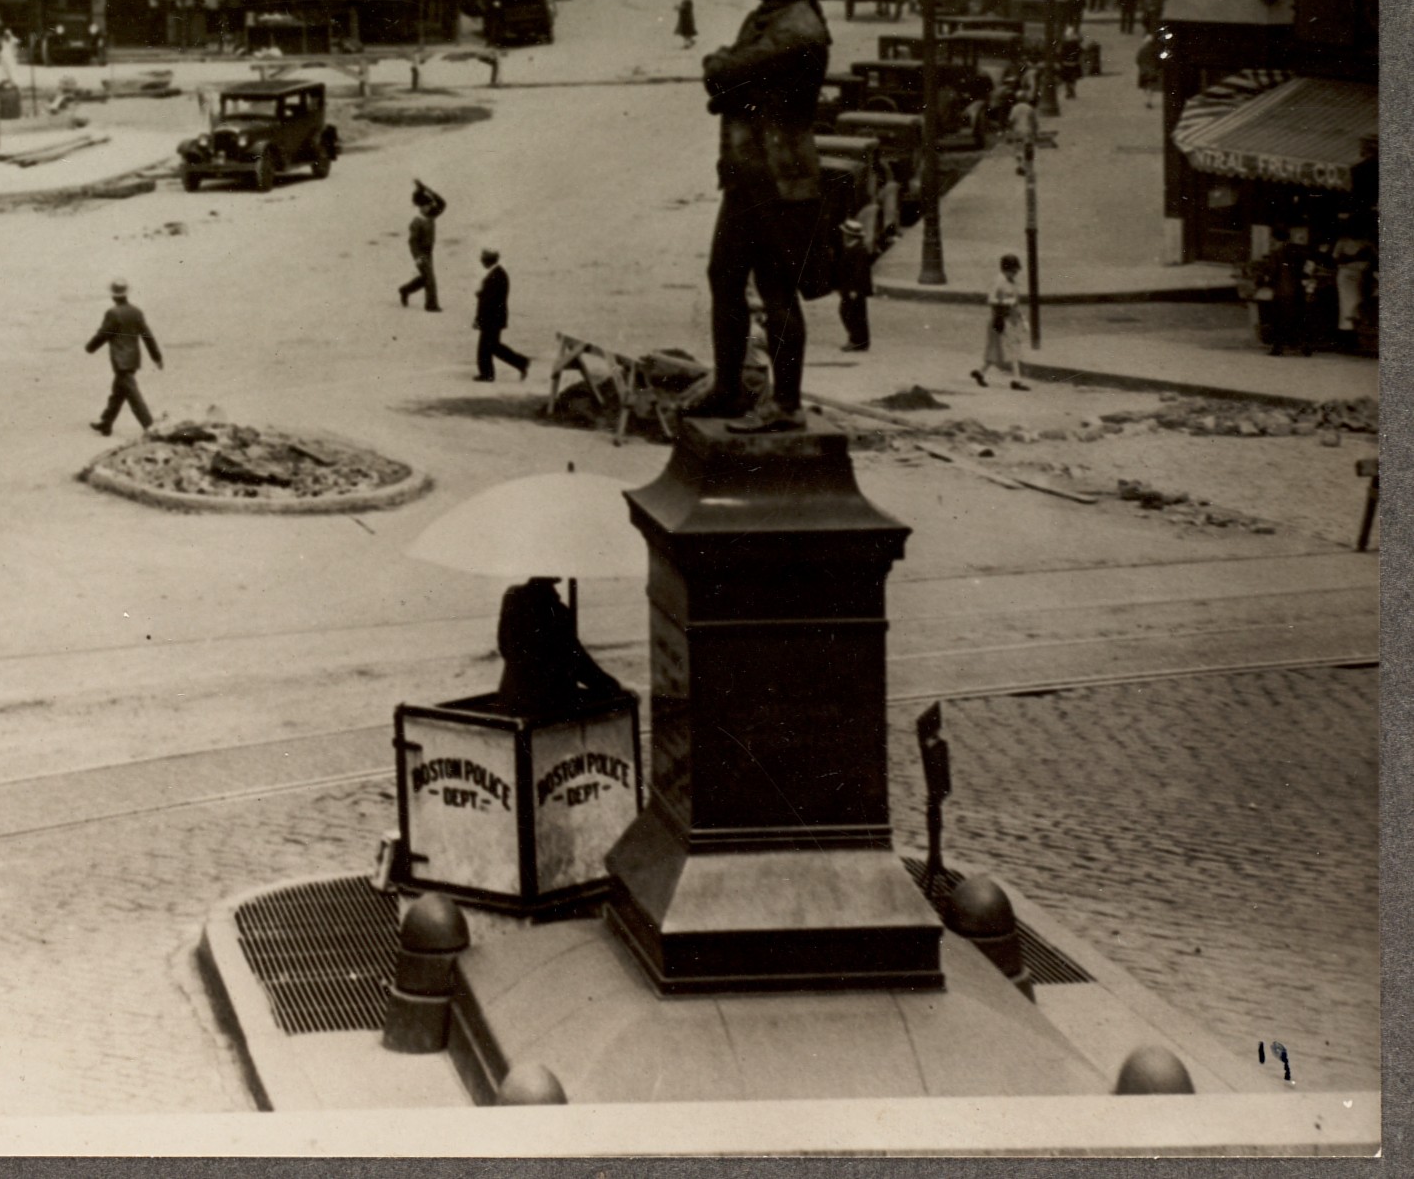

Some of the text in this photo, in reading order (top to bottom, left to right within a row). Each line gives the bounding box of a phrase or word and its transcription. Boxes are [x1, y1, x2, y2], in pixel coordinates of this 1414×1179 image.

[1257, 154, 1303, 178] FRUIT
[412, 757, 511, 812] BOSTON POLICE
[536, 752, 631, 807] BOSTON POLICE
